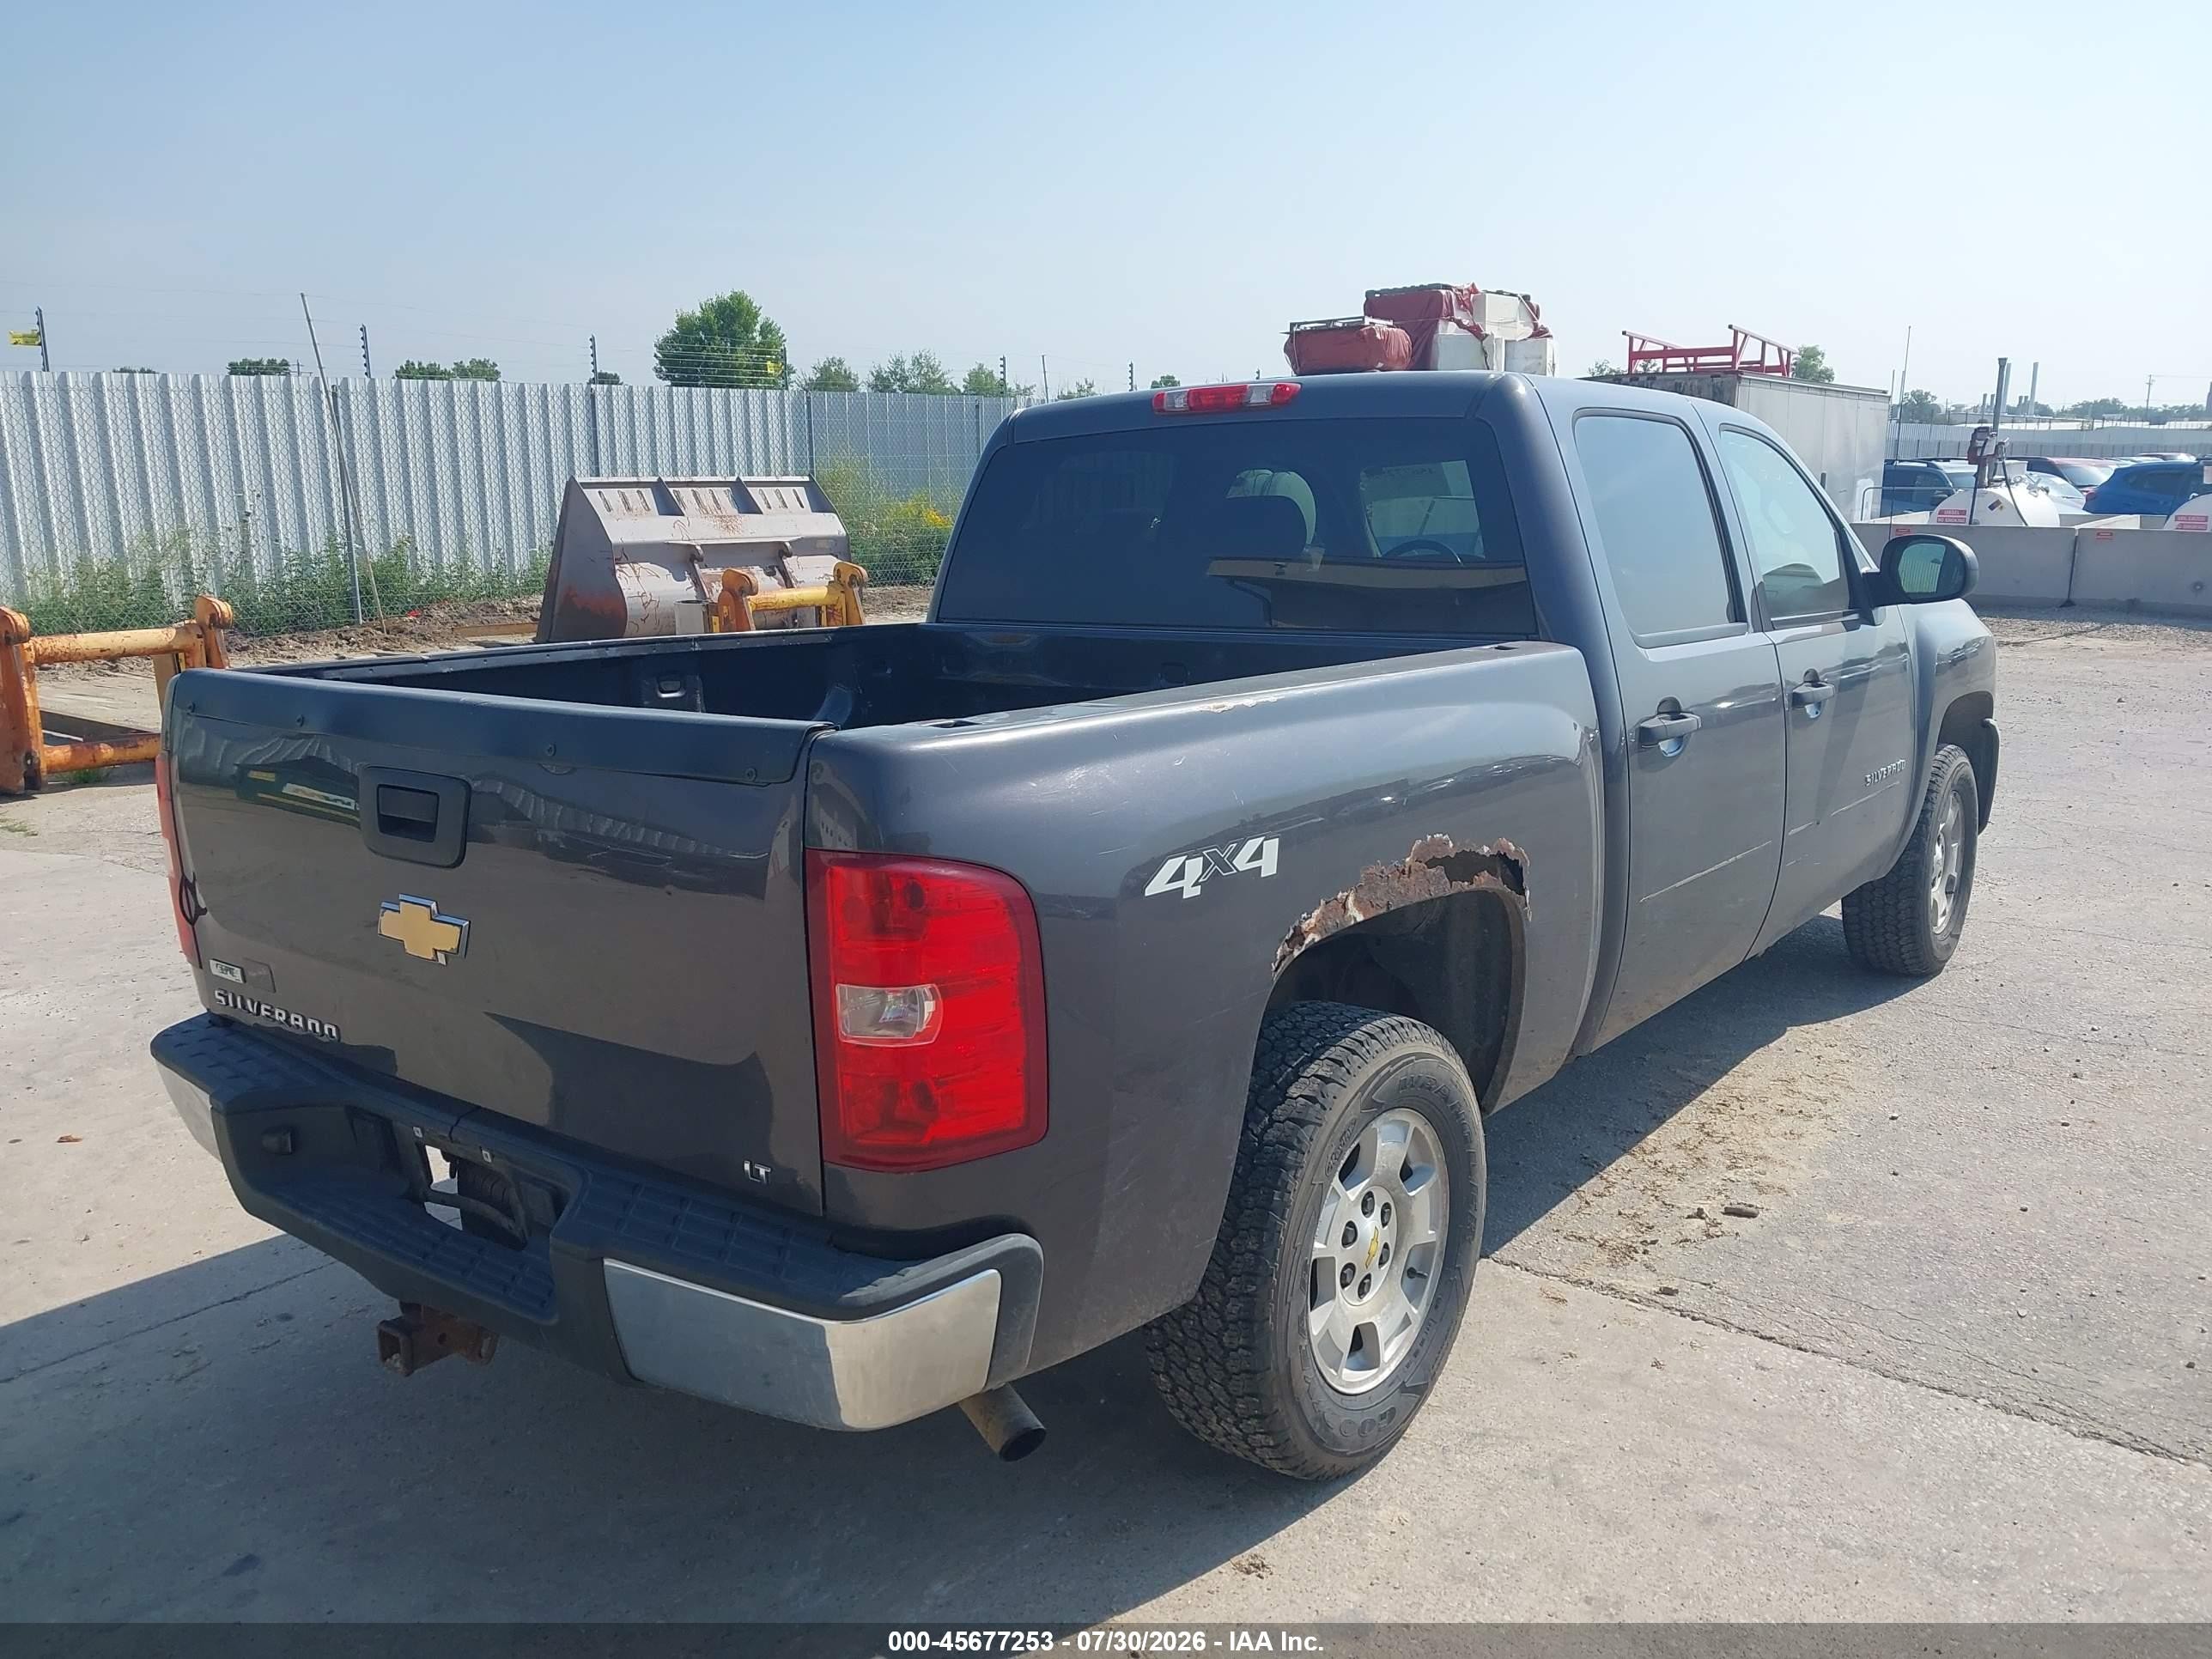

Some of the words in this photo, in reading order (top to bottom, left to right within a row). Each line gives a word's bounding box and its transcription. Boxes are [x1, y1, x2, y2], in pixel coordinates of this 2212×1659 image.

[1865, 759, 1906, 787] SILVERADO
[214, 988, 341, 1042] SILVERADO
[744, 1160, 771, 1184] LT
